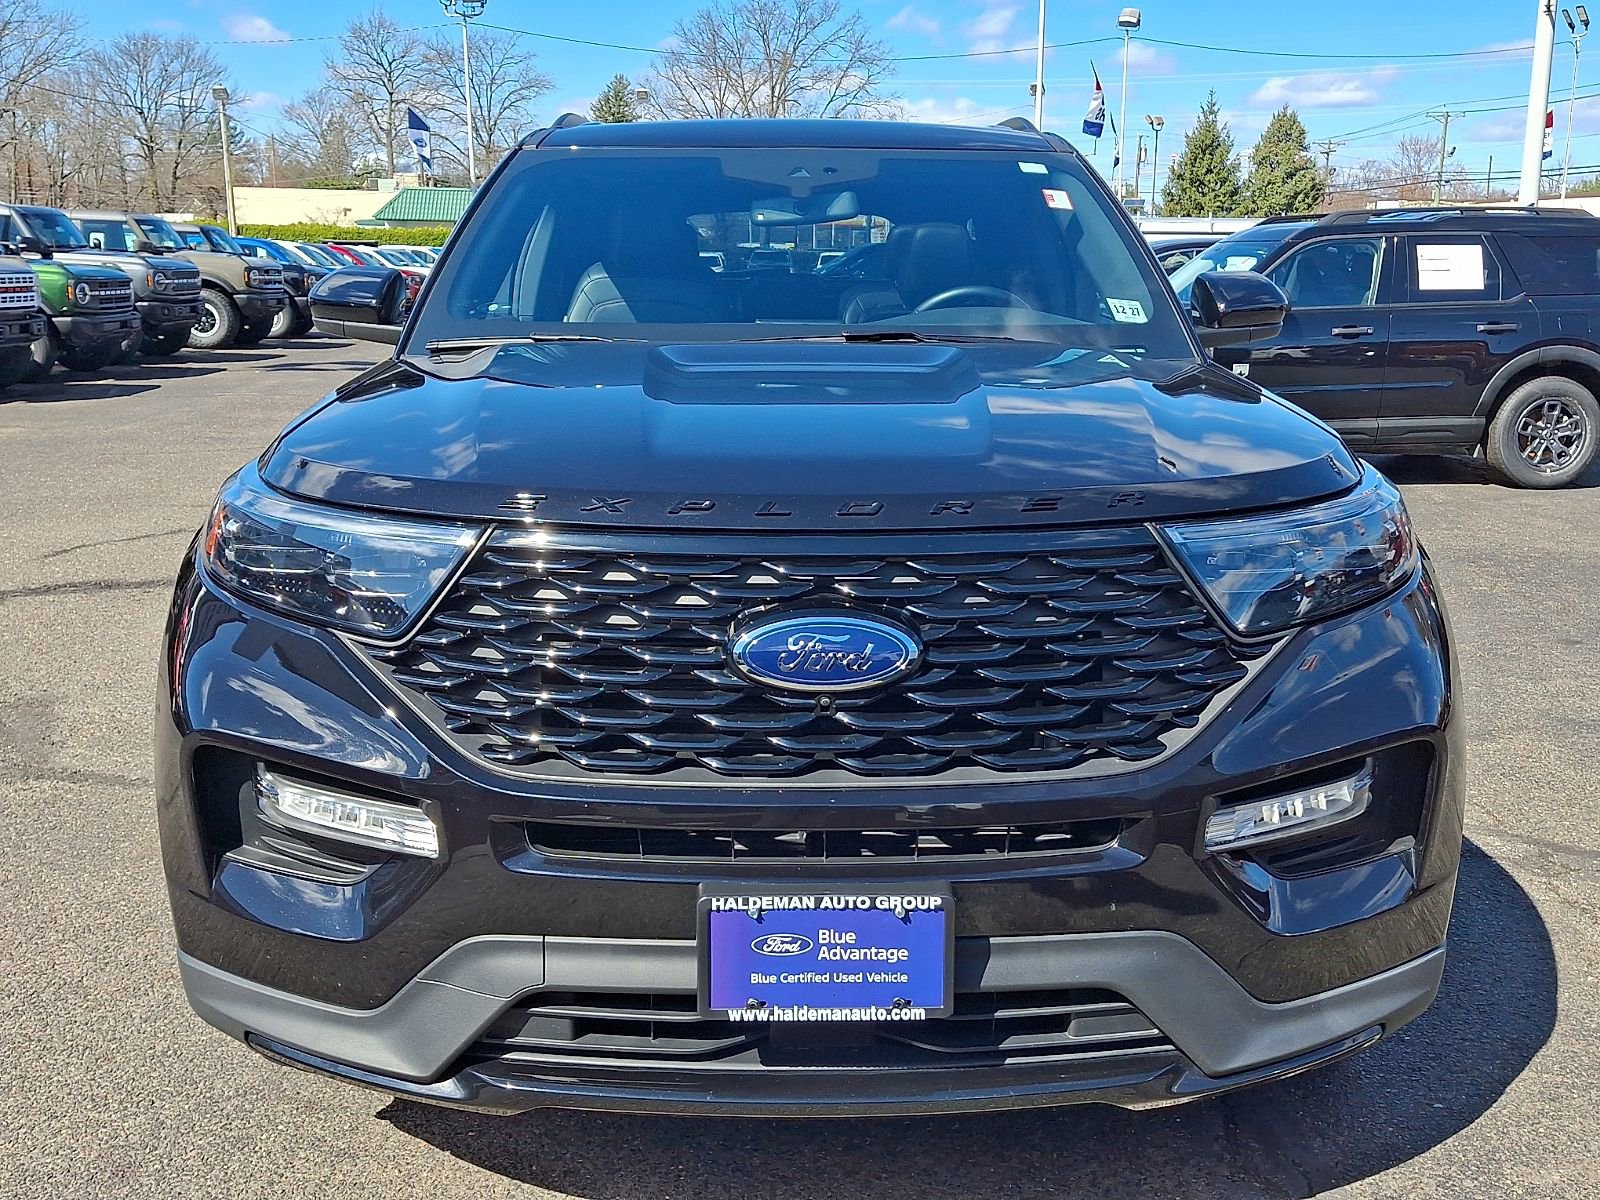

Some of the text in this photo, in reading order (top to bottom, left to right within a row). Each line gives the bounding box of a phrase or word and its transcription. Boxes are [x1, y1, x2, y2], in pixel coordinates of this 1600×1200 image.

[1113, 304, 1141, 316] 12 27
[497, 490, 1146, 517] EXPLORER
[777, 632, 875, 673] Ford
[711, 896, 942, 911] HALDEMAN AUTO GROUP
[762, 936, 802, 953] Ford
[817, 929, 856, 944] Blue
[817, 946, 909, 963] Advantage
[750, 972, 908, 984] Blue Certified Used Vehicle
[727, 1006, 926, 1022] www.haldemanauto.com
